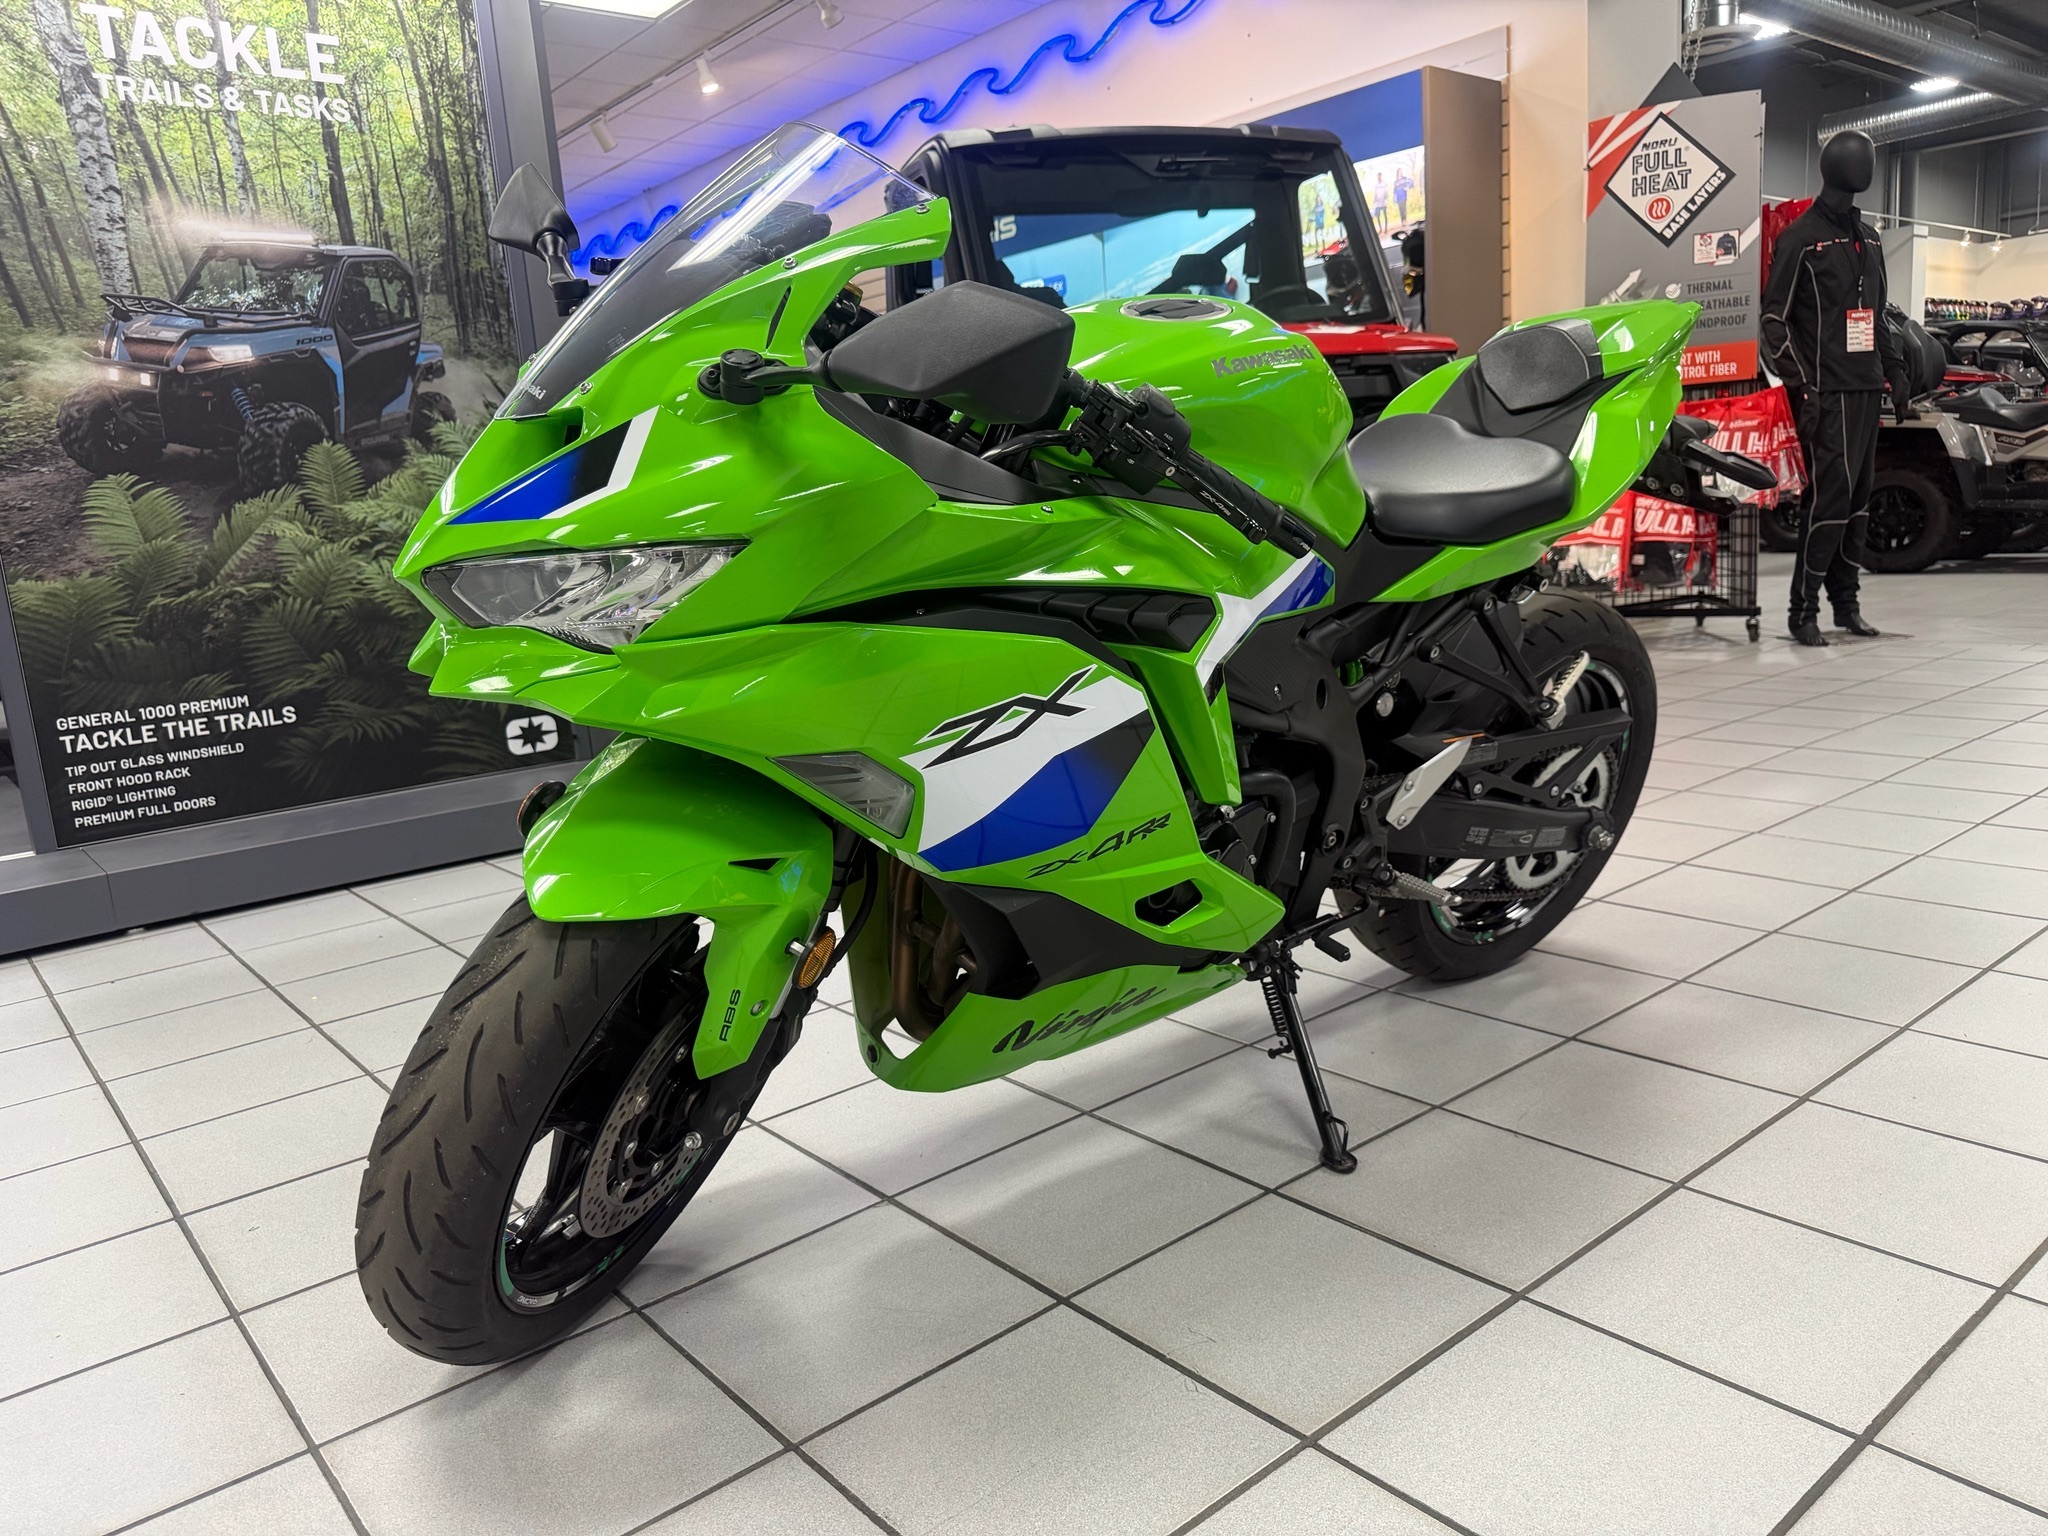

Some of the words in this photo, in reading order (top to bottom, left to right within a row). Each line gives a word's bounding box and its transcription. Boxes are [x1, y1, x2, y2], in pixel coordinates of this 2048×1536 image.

[80, 3, 345, 85] TACKLE
[92, 72, 214, 109] TRAILS
[219, 86, 245, 112] &
[253, 89, 351, 123] TASKS
[1641, 137, 1678, 152] NORU
[1632, 147, 1687, 176] FULL
[1632, 168, 1692, 197] HEAT
[1662, 208, 1691, 239] BASE
[1687, 170, 1727, 212] LAYERS
[1687, 279, 1734, 294] THERMAL
[1699, 295, 1751, 311] EATHABLE
[1695, 314, 1748, 329] INDPROOF
[296, 334, 333, 346] 1000
[1211, 344, 1315, 378] Kawasaki
[1694, 350, 1720, 364] WITH
[1709, 362, 1738, 377] FIBER
[1163, 432, 1174, 441] PASS
[56, 709, 136, 731] GENERAL
[139, 704, 176, 720] 1000
[179, 695, 250, 715] PREMIUM
[918, 664, 1097, 770] ZX
[59, 724, 158, 754] TACKLE
[162, 718, 210, 740] THE
[214, 705, 297, 733] TRAILS
[65, 764, 87, 778] TIP
[90, 760, 116, 774] OUT
[120, 754, 164, 770] GLASS
[167, 742, 245, 763] WINDSHIELD
[68, 778, 113, 795] FRONT
[117, 772, 153, 787] HOOD
[156, 766, 191, 781] RACK
[116, 785, 177, 805] LIGHTING
[74, 809, 135, 828] PREMIUM
[138, 803, 171, 818] FULL
[174, 796, 217, 812] DOORS
[1024, 812, 1172, 880] ZX-4RR
[719, 989, 741, 1042] ABS
[992, 986, 1167, 1053] Ninja
